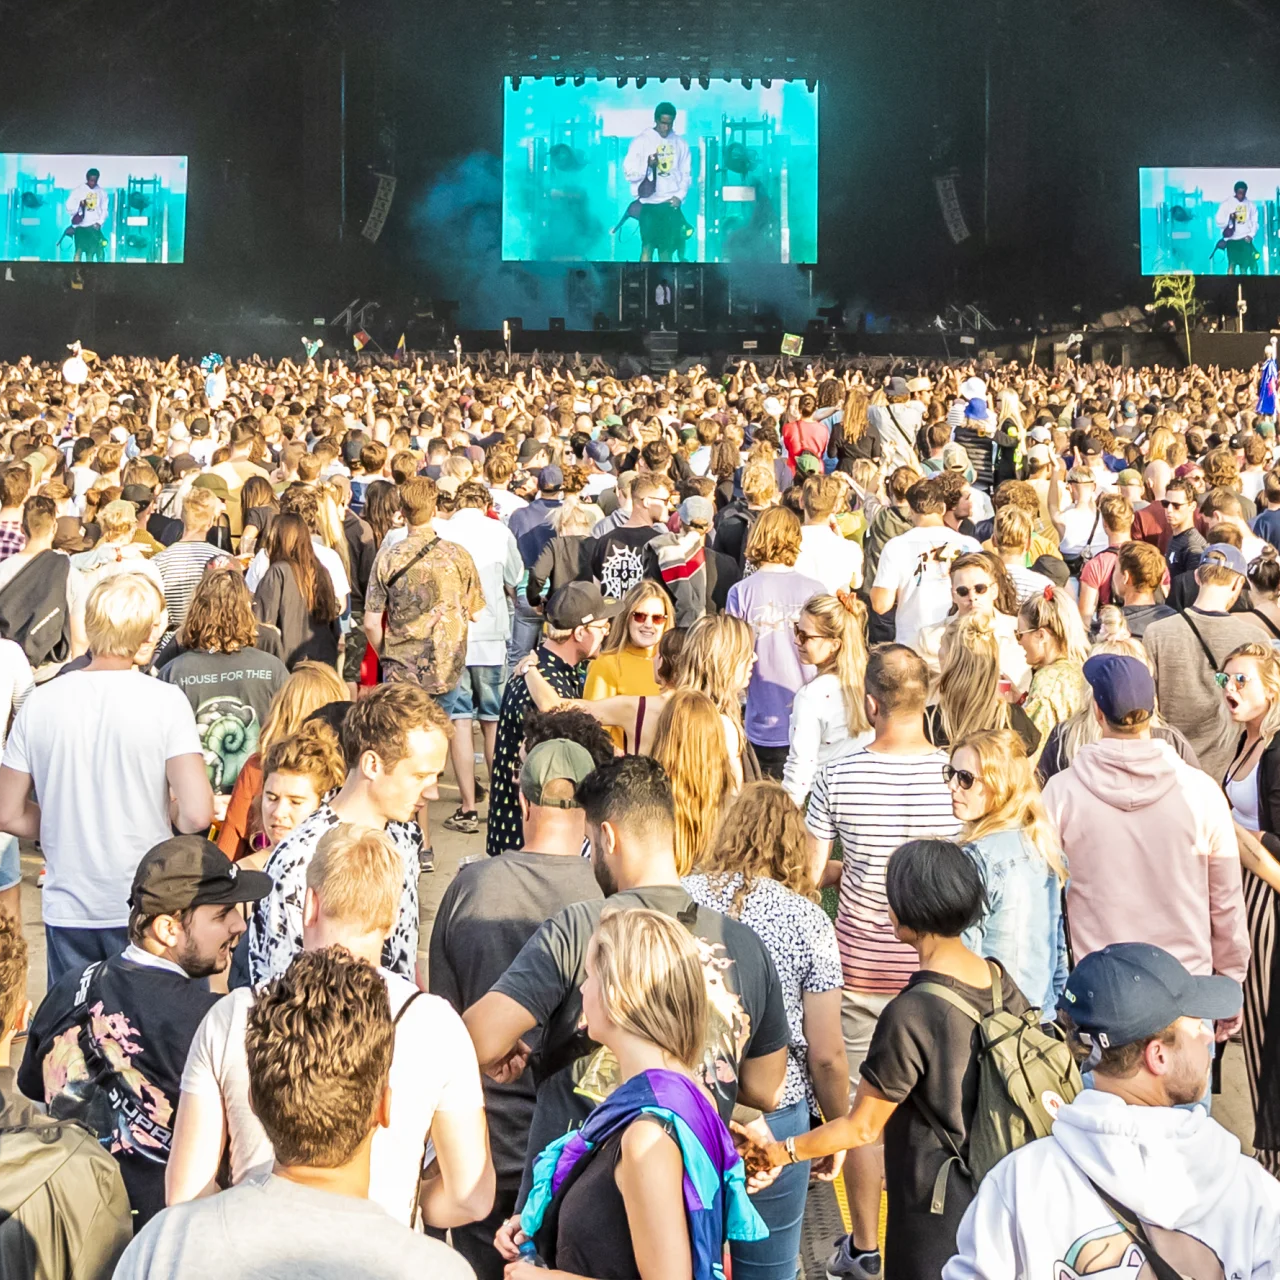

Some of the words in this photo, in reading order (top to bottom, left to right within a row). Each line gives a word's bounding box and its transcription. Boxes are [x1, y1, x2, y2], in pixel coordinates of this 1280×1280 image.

[181, 674, 218, 686] HOUSE
[220, 671, 243, 682] FOR
[246, 669, 273, 680] THEE
